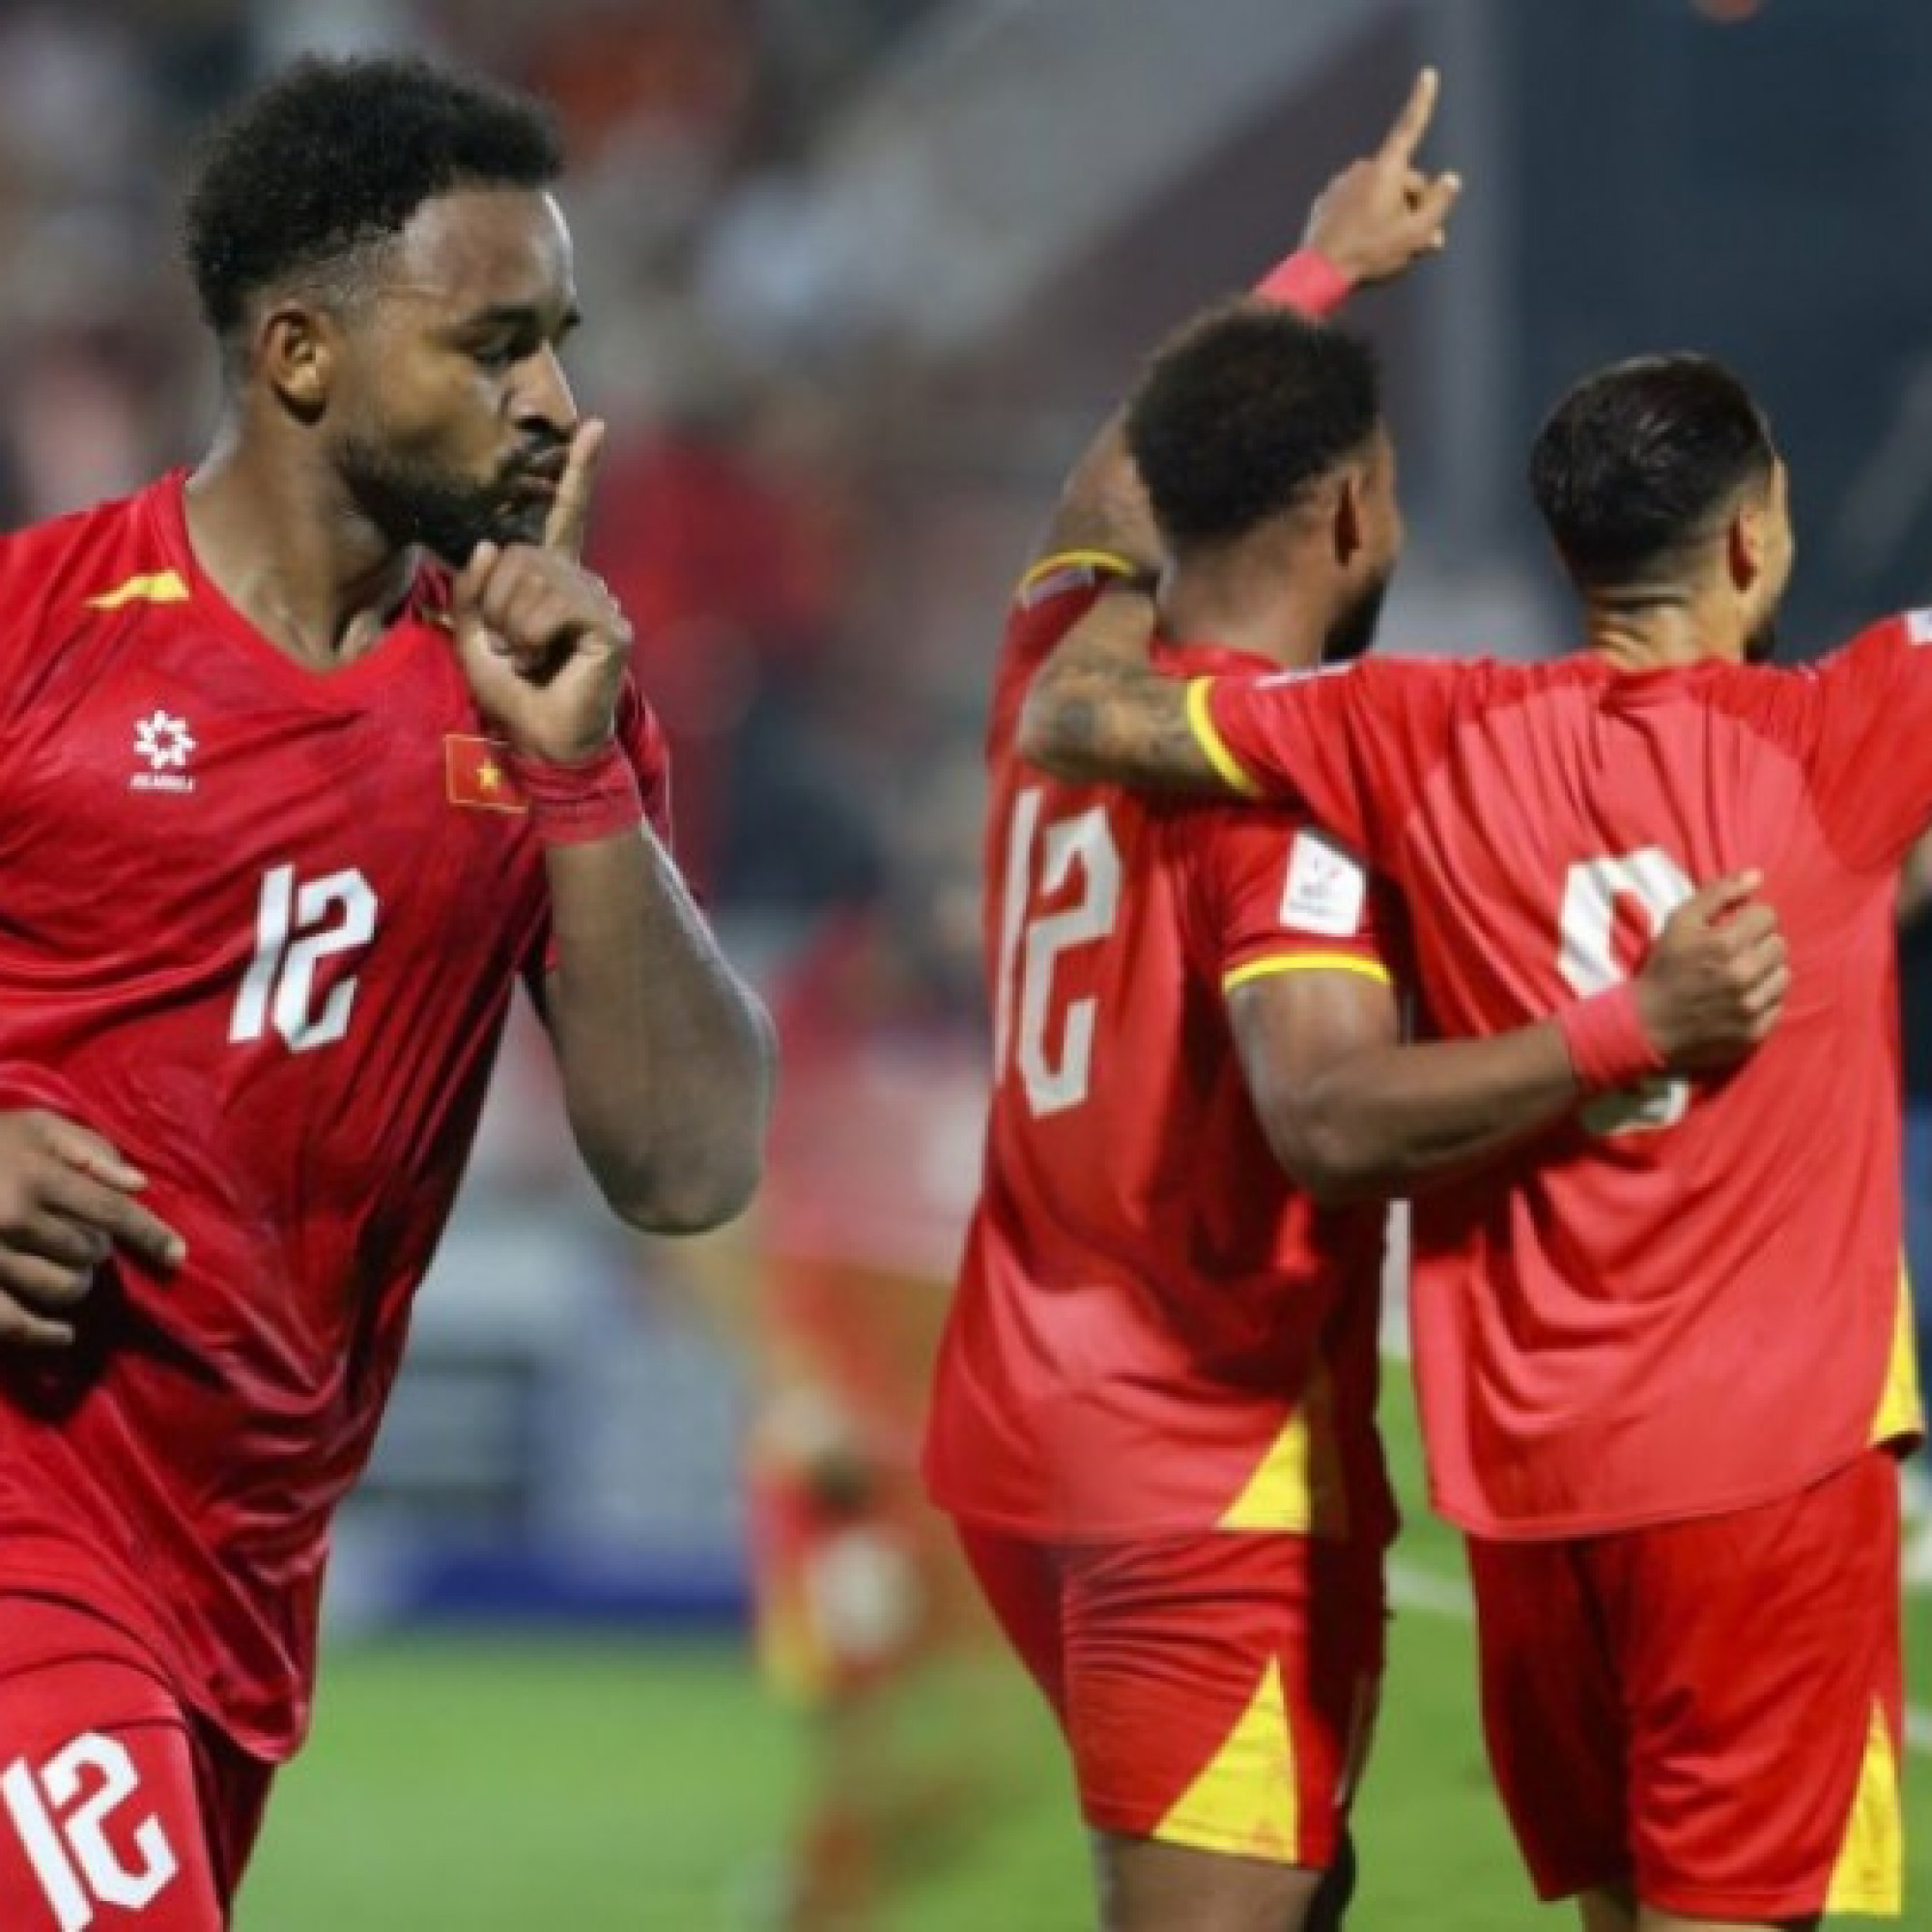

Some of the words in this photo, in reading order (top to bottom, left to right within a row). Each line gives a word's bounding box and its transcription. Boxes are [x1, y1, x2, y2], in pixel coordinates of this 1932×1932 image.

[228, 863, 379, 1053] 12
[994, 787, 1124, 1119] 12
[0, 1731, 180, 1932] 12
